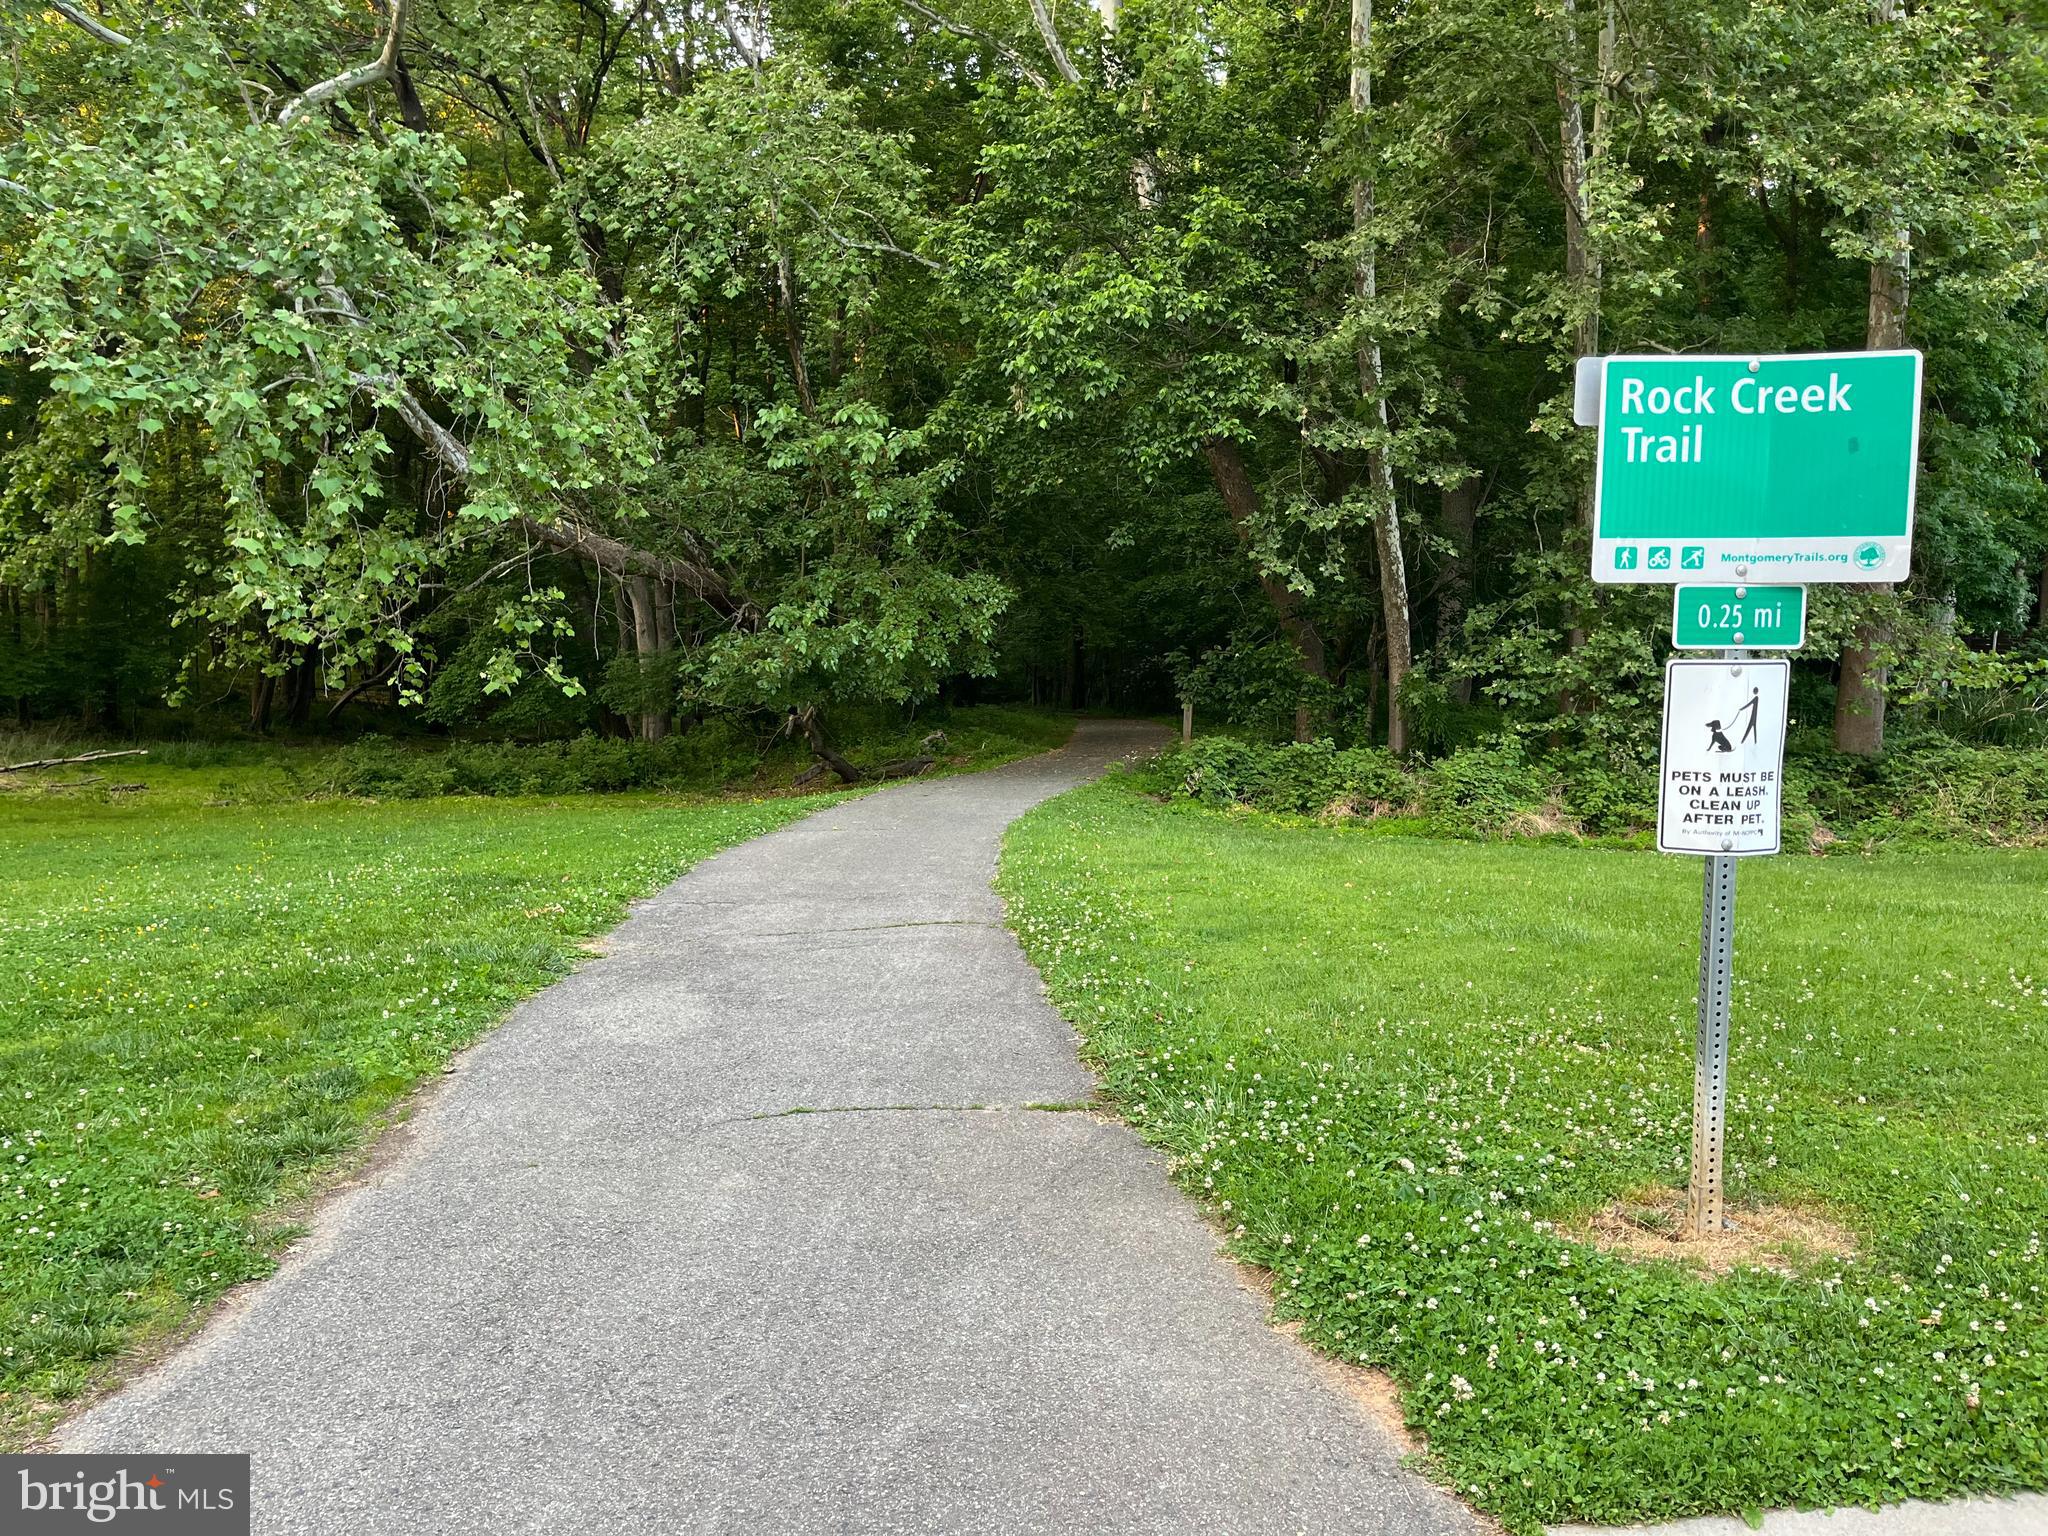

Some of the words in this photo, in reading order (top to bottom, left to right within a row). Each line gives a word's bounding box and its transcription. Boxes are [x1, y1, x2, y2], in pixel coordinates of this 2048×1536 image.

[1621, 375, 1716, 415] Rock
[1731, 373, 1853, 414] Creek
[1621, 424, 1703, 463] Trail
[1720, 552, 1849, 564] MontgomeryTrails.org
[1698, 603, 1743, 629] 0.25
[1754, 601, 1782, 628] mi
[1672, 771, 1712, 782] PETS
[1720, 772, 1756, 783] MUST
[1760, 771, 1774, 781] BE
[1679, 785, 1701, 796] ON
[1709, 786, 1719, 797] A
[1727, 786, 1768, 797] LEASH.
[1689, 799, 1741, 811] CLEAN
[1747, 800, 1760, 810] UP
[1683, 813, 1734, 824] AFTER
[1741, 813, 1764, 825] PET.
[1693, 829, 1722, 837] Authority
